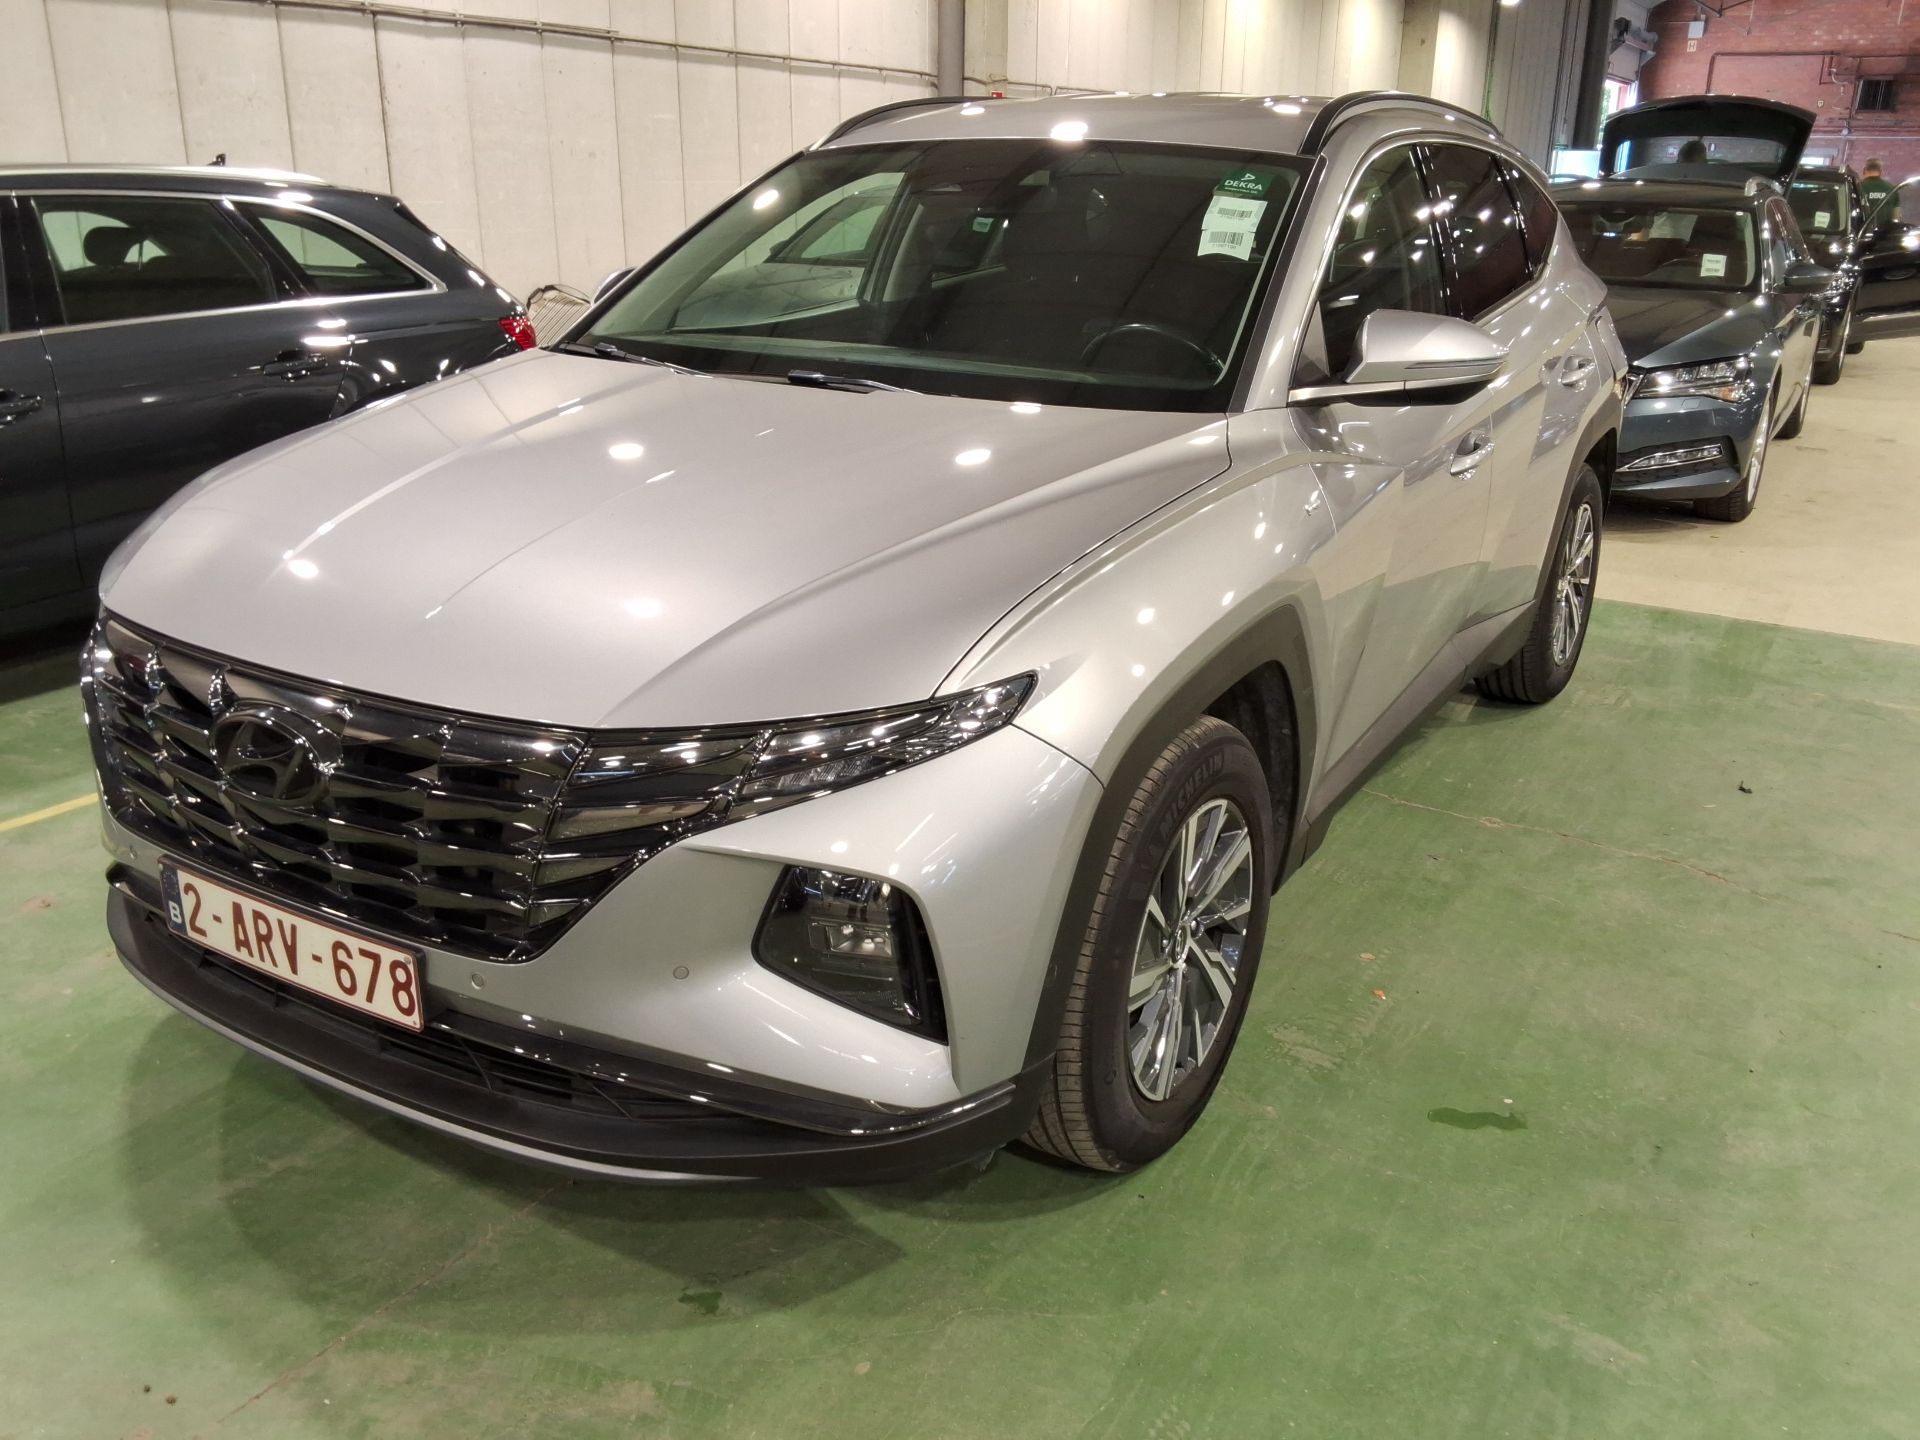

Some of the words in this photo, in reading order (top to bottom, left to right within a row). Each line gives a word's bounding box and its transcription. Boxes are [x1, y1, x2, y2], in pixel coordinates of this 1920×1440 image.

[1224, 179, 1263, 191] DEKRA
[1159, 748, 1225, 839] MICHELIN
[168, 900, 182, 924] B
[183, 882, 417, 1017] 2-ARV-678
